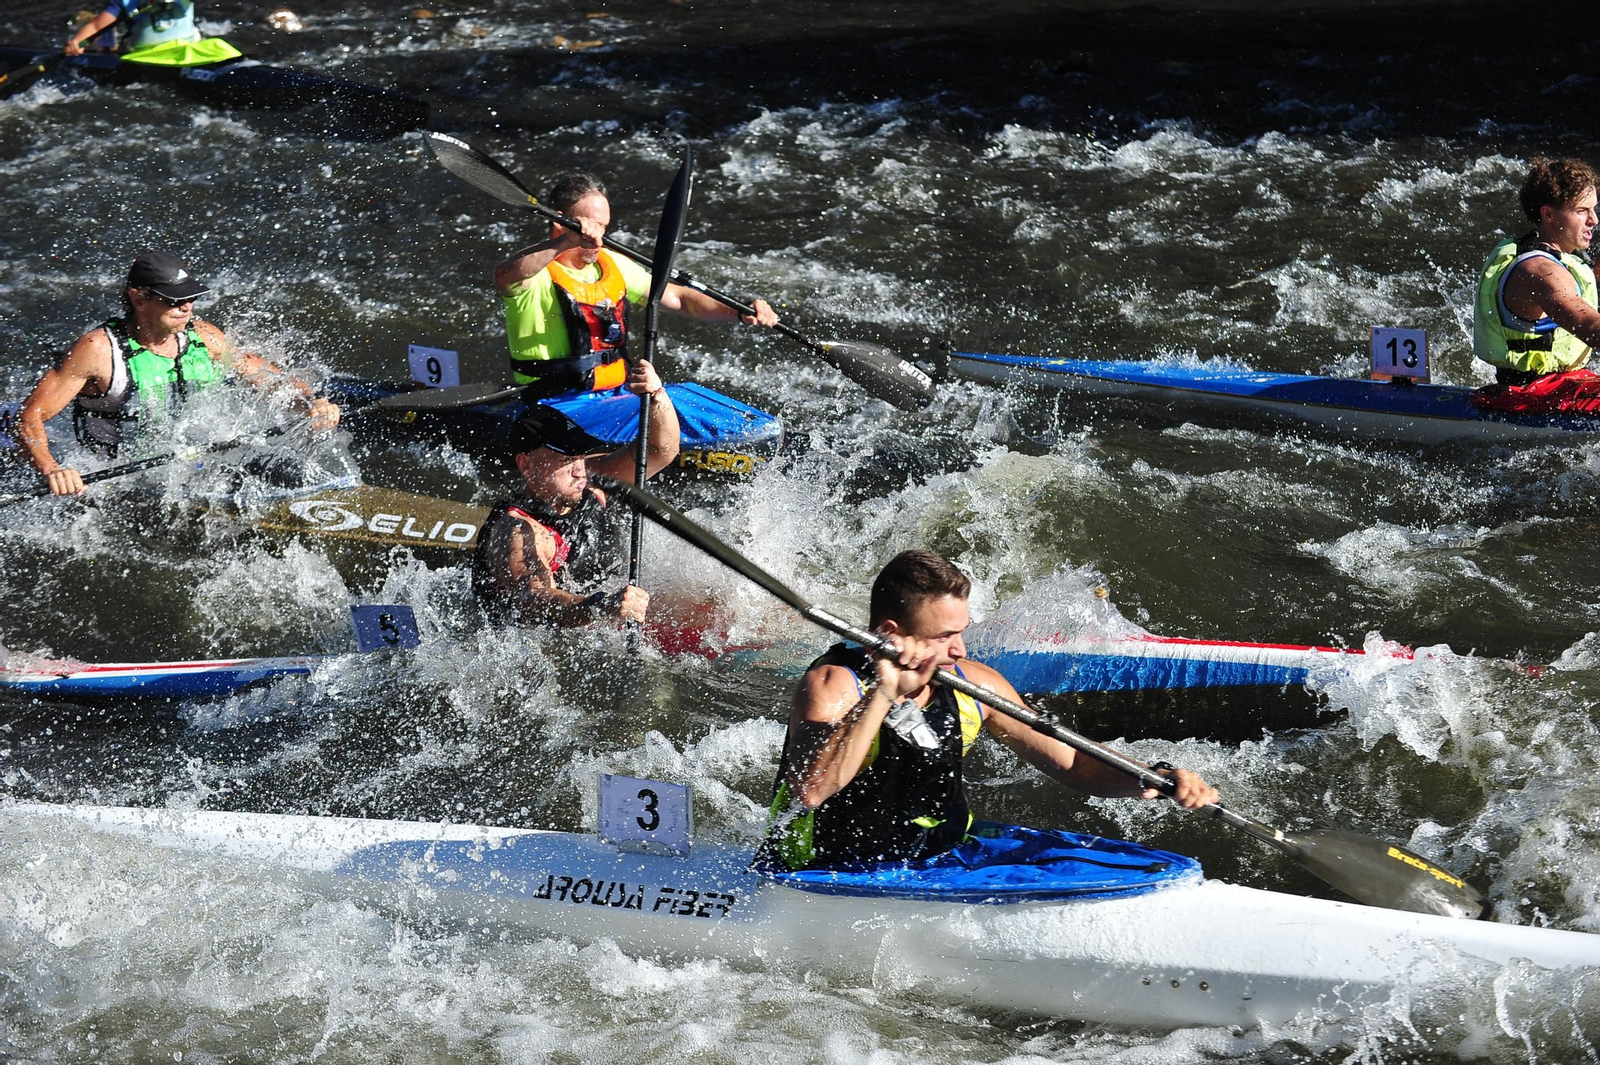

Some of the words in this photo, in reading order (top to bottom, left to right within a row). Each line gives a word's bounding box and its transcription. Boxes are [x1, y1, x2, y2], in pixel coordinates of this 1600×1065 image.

[1386, 337, 1418, 368] 13
[426, 356, 442, 384] 9
[368, 512, 478, 543] ELIO
[379, 613, 399, 645] 5
[636, 788, 660, 831] 3
[533, 875, 645, 910] AROUSA
[652, 886, 736, 918] FIBER
